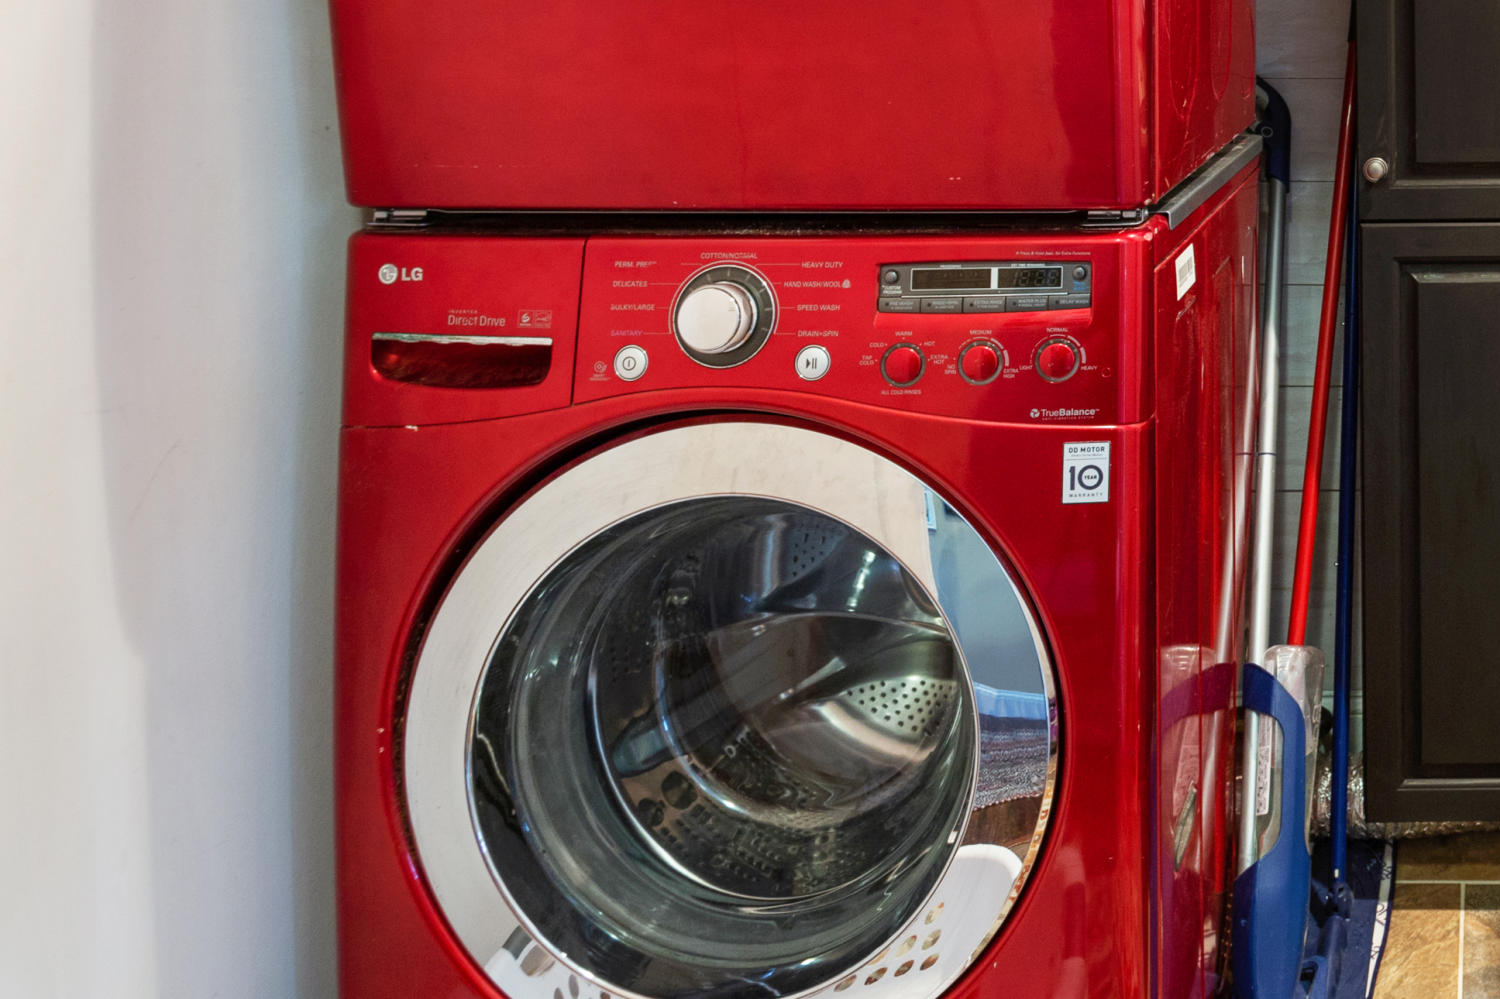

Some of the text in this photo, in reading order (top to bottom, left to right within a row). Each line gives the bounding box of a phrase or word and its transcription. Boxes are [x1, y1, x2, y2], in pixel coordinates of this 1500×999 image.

[401, 267, 423, 281] LG
[612, 280, 648, 288] DELICATES
[447, 314, 478, 326] Direct
[479, 315, 506, 327] Drive
[1068, 464, 1104, 491] 10
